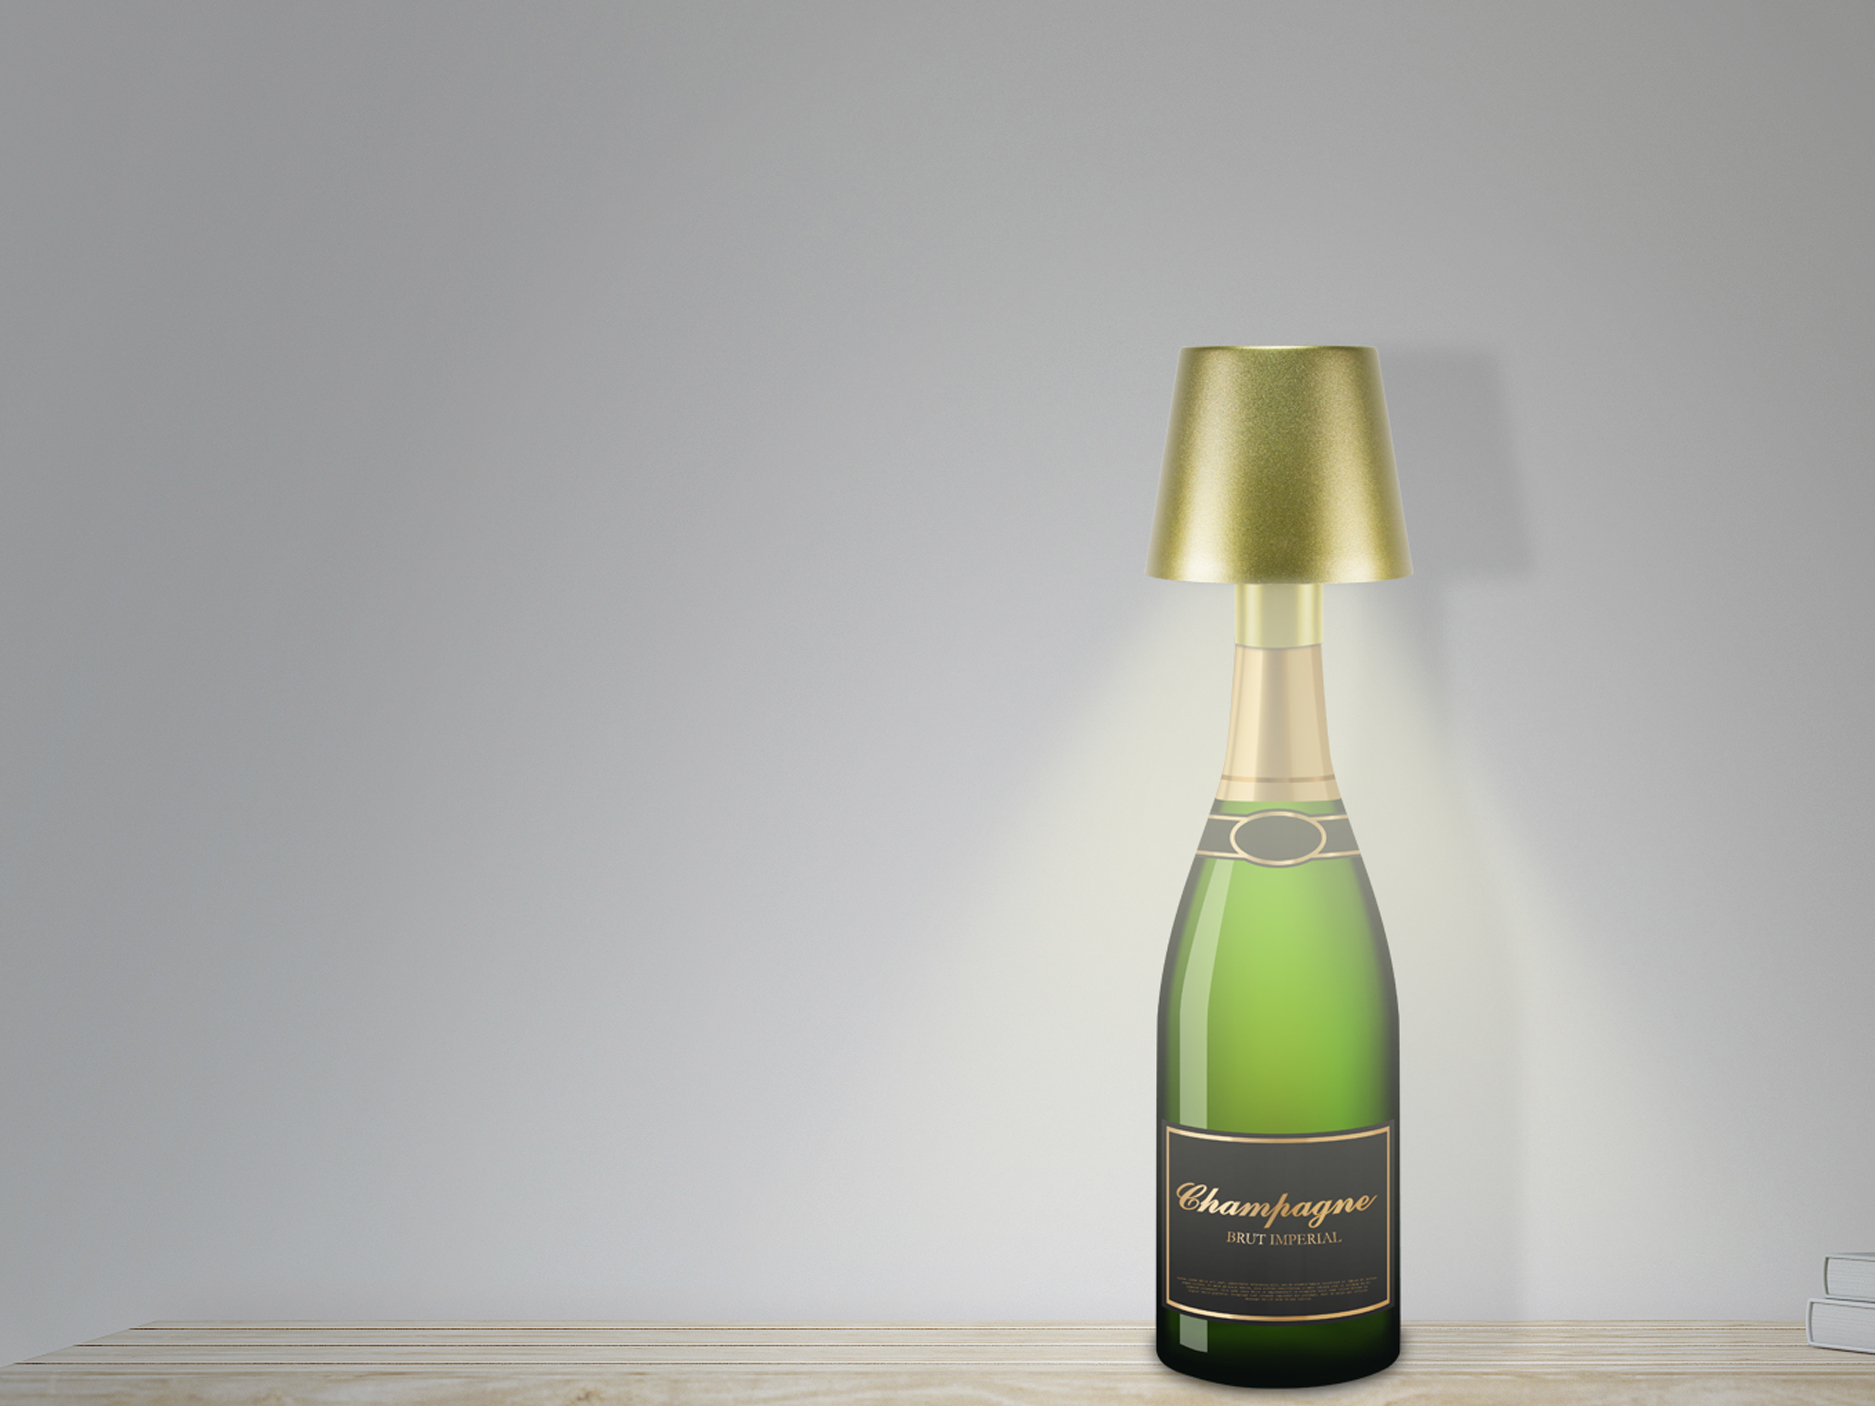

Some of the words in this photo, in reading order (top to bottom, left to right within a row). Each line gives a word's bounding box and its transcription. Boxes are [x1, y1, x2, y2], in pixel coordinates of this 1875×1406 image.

[1176, 1182, 1378, 1229] Champagne
[1226, 1231, 1266, 1246] BRUT
[1269, 1231, 1343, 1246] IMPERIAL
